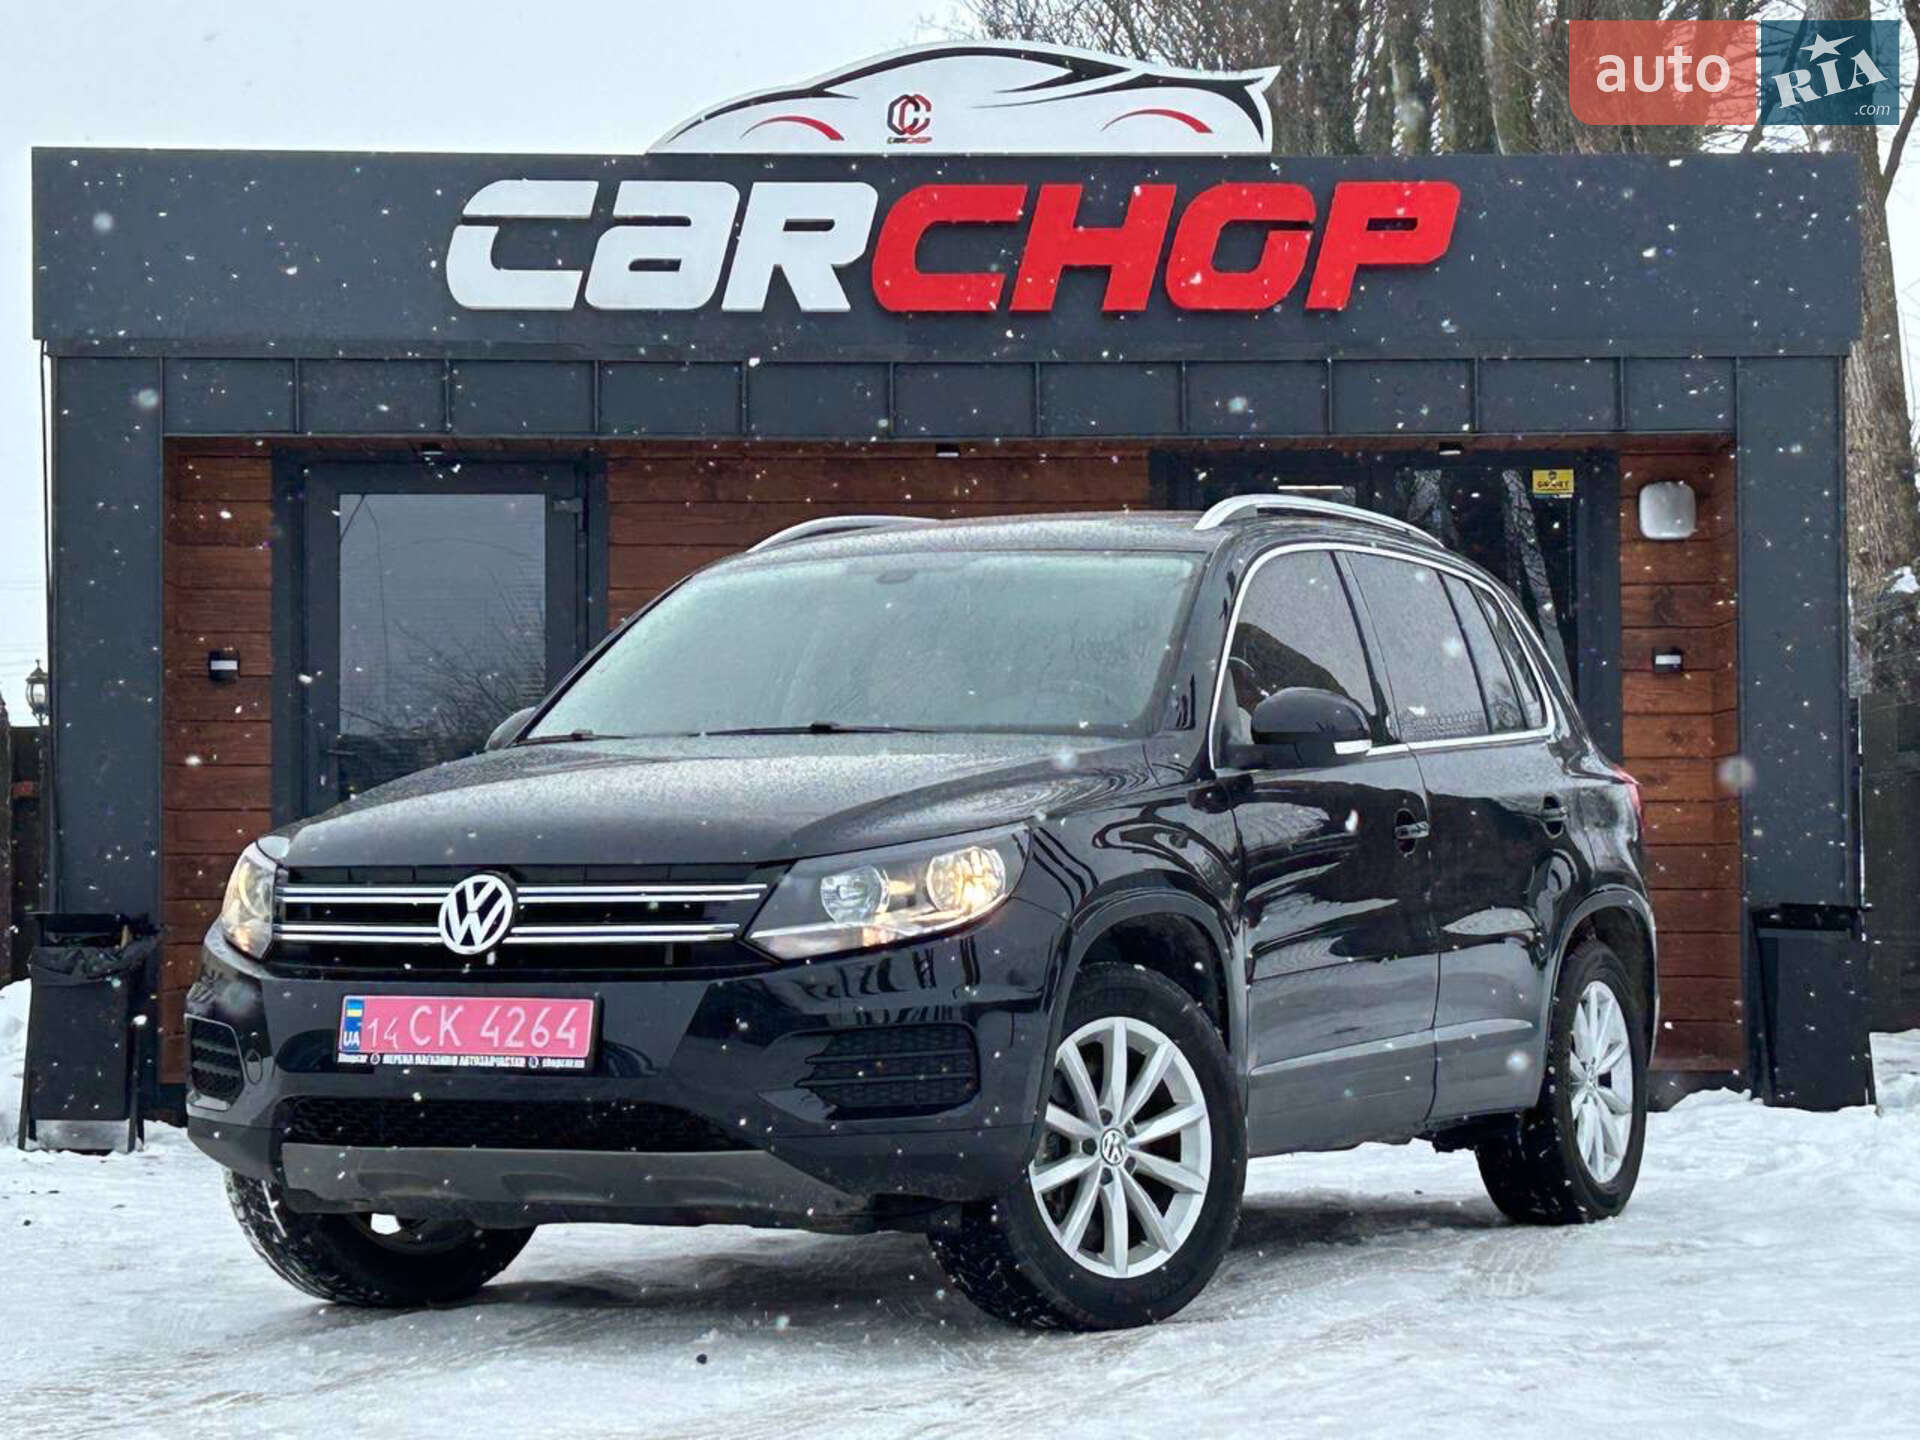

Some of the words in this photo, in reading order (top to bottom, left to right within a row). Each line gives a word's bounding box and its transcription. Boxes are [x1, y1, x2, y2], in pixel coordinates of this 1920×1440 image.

[343, 1031, 360, 1047] UA
[367, 1017, 398, 1050] 14
[409, 1005, 464, 1047] CK
[480, 1006, 578, 1049] 4264
